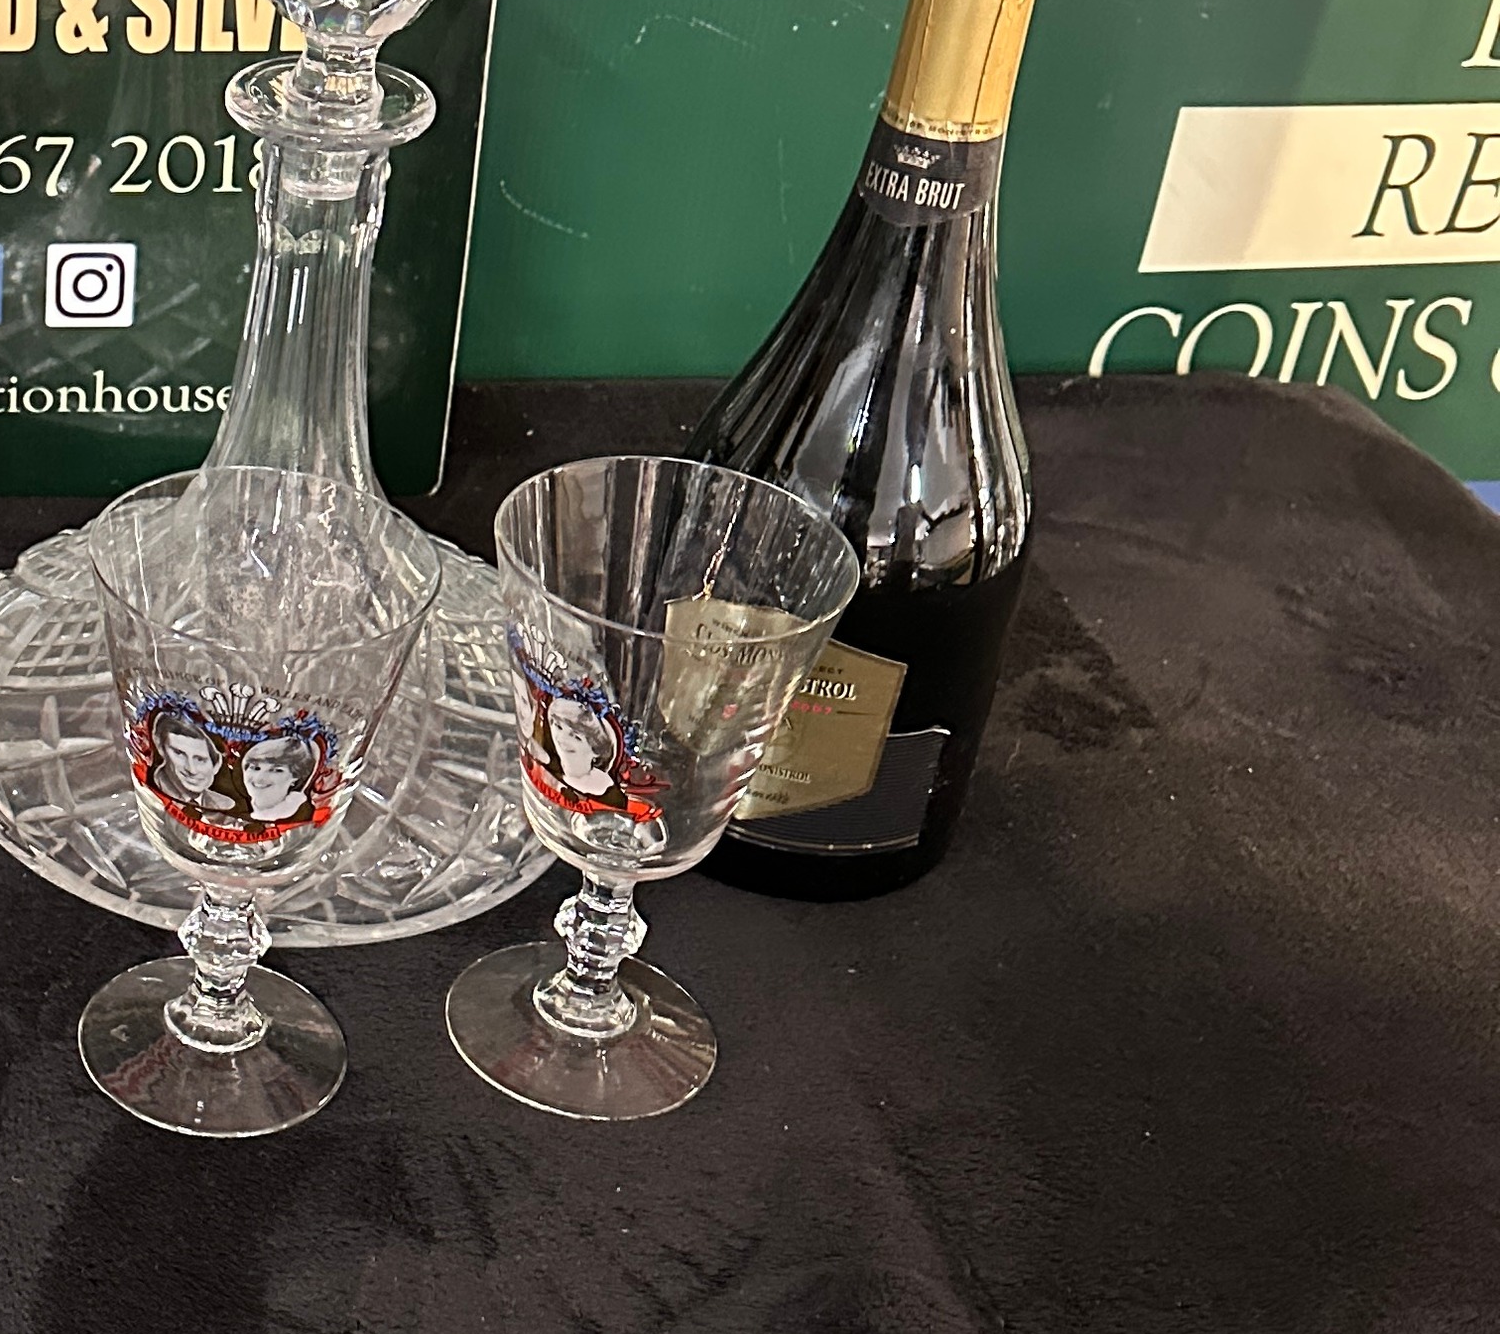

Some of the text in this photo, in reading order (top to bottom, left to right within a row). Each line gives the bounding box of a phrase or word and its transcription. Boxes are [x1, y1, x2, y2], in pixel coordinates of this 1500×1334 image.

[865, 161, 966, 210] EXTRA BRUT
[1088, 297, 1472, 401] COINS
